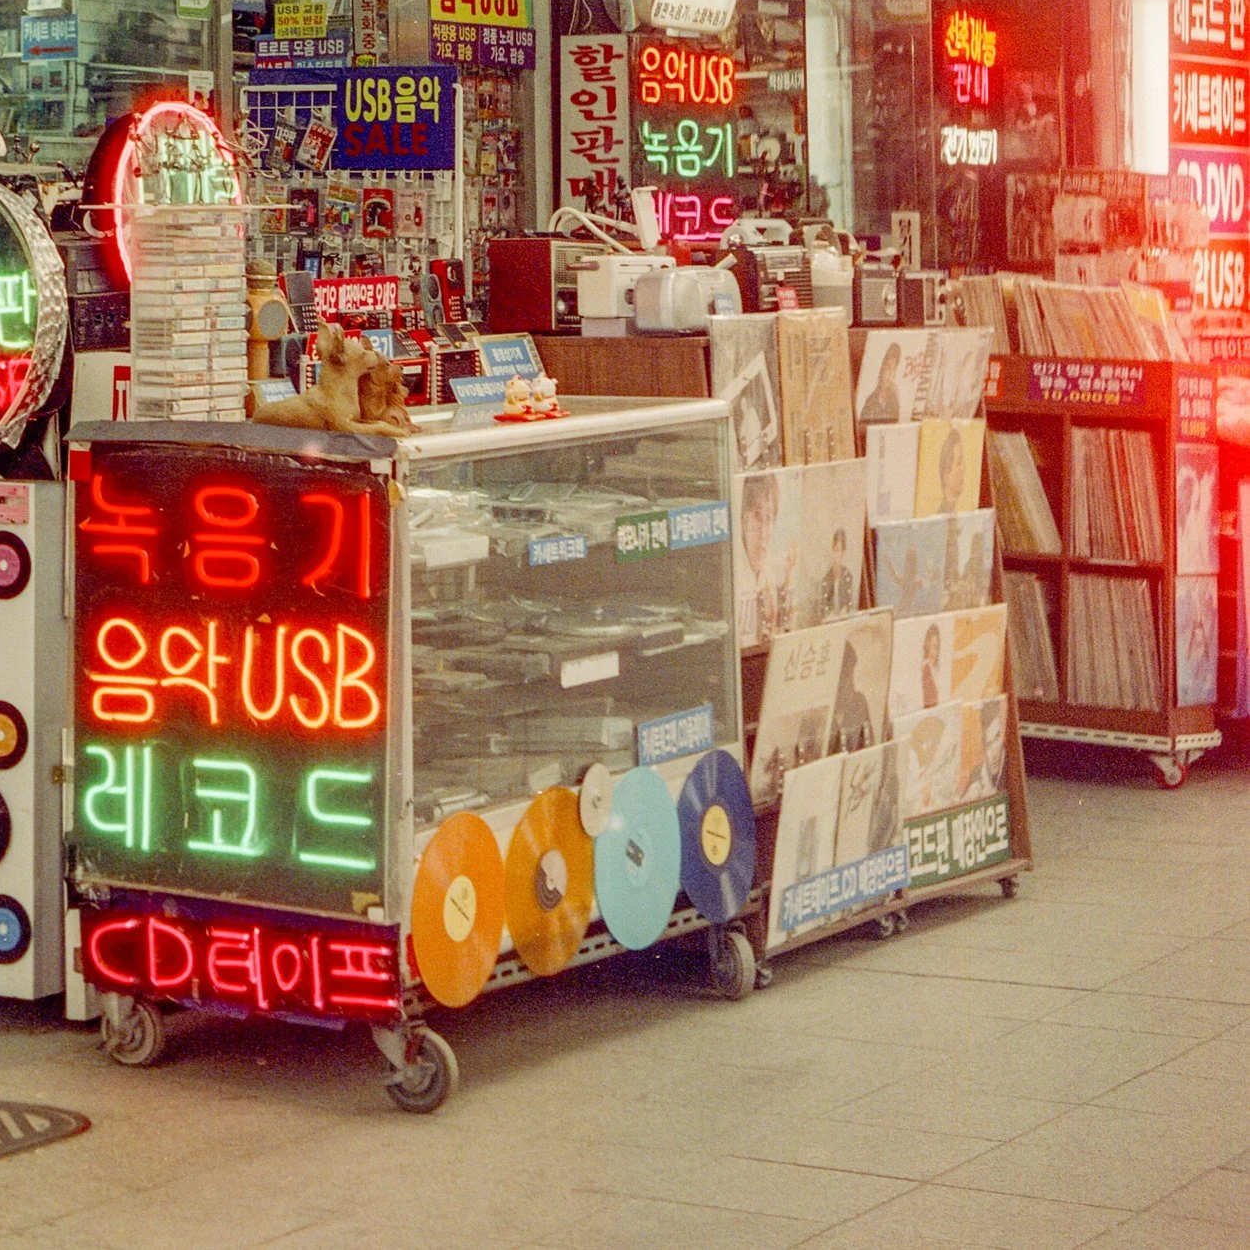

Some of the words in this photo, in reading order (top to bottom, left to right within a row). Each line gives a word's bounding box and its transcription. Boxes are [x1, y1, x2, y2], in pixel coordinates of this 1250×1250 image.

[277, 5, 300, 15] USB
[303, 4, 323, 15] 교환
[277, 16, 300, 26] 50%
[22, 19, 50, 43] 카세트
[50, 19, 77, 42] 테이프
[432, 23, 457, 42] 차량용
[458, 26, 477, 42] USB
[499, 29, 514, 46] 노래
[515, 30, 533, 47] USB
[257, 40, 290, 57] 트로트
[292, 40, 315, 57] 모음
[318, 39, 345, 55] USB
[457, 43, 473, 62] 팝송
[639, 46, 734, 105] 음악USB
[344, 75, 442, 124] USB음악
[342, 123, 430, 157] SALE
[640, 118, 734, 178] 녹음기
[79, 472, 374, 599] 녹음기
[87, 616, 382, 730] 음악USB
[83, 744, 378, 872] 레코드
